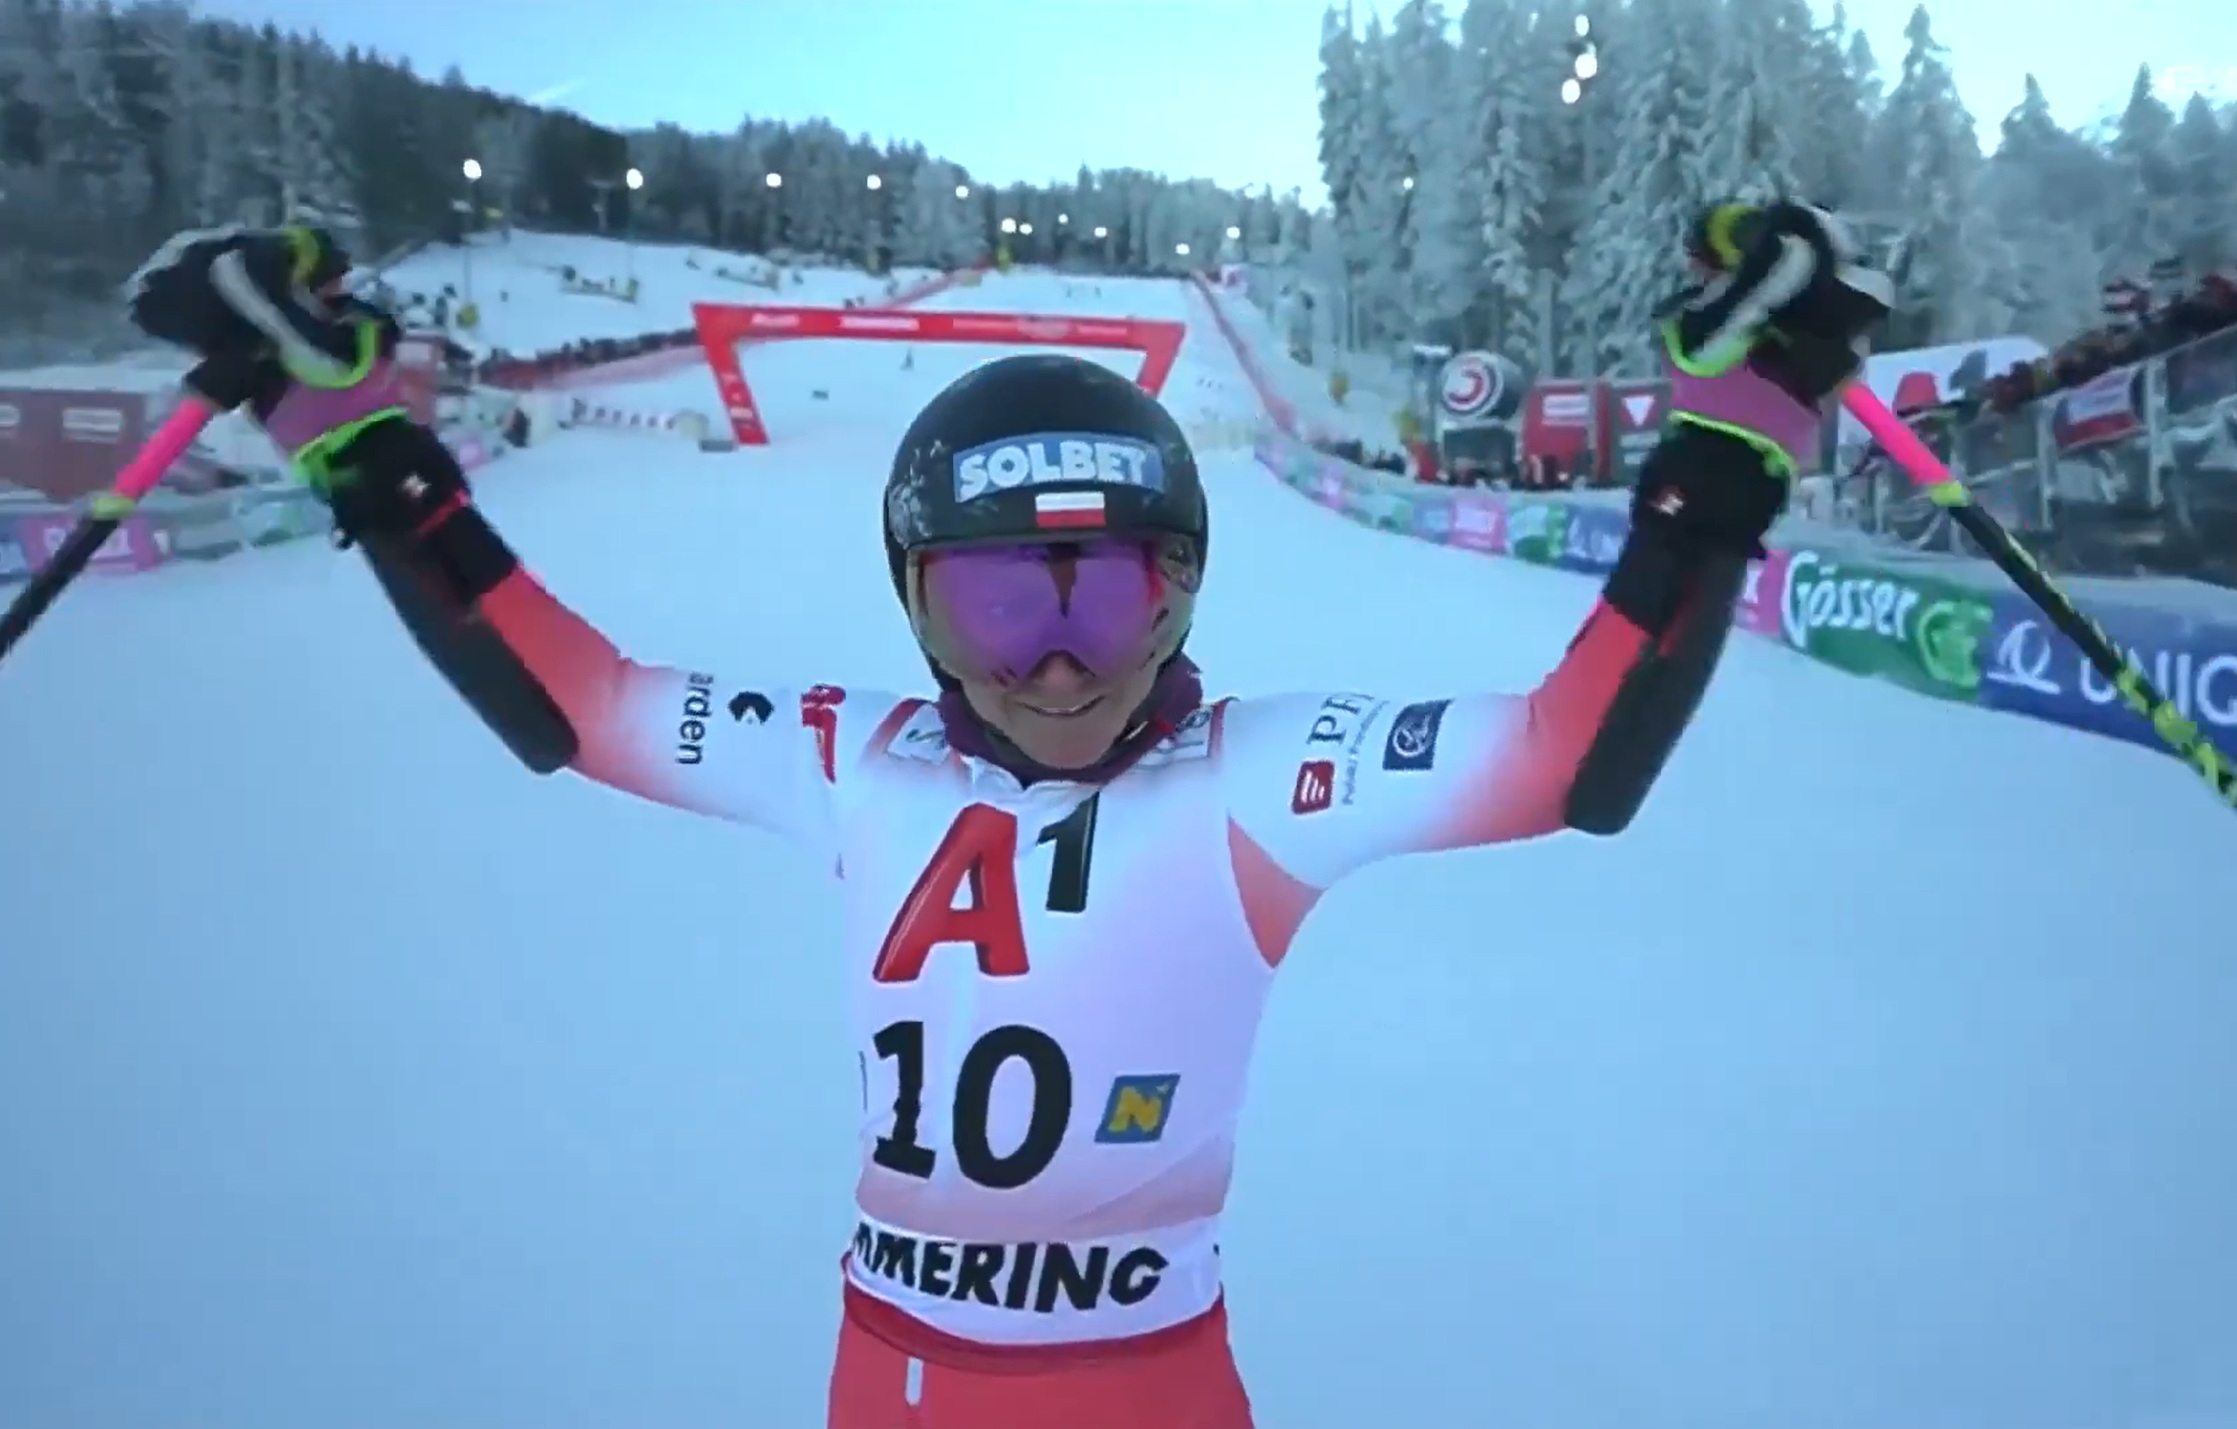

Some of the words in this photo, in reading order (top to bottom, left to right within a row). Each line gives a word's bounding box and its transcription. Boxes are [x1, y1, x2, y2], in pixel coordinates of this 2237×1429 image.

[959, 440, 1146, 501] SOLBET
[1781, 550, 1920, 648] Gösser
[873, 792, 1100, 983] A1
[873, 1021, 1072, 1190] 10
